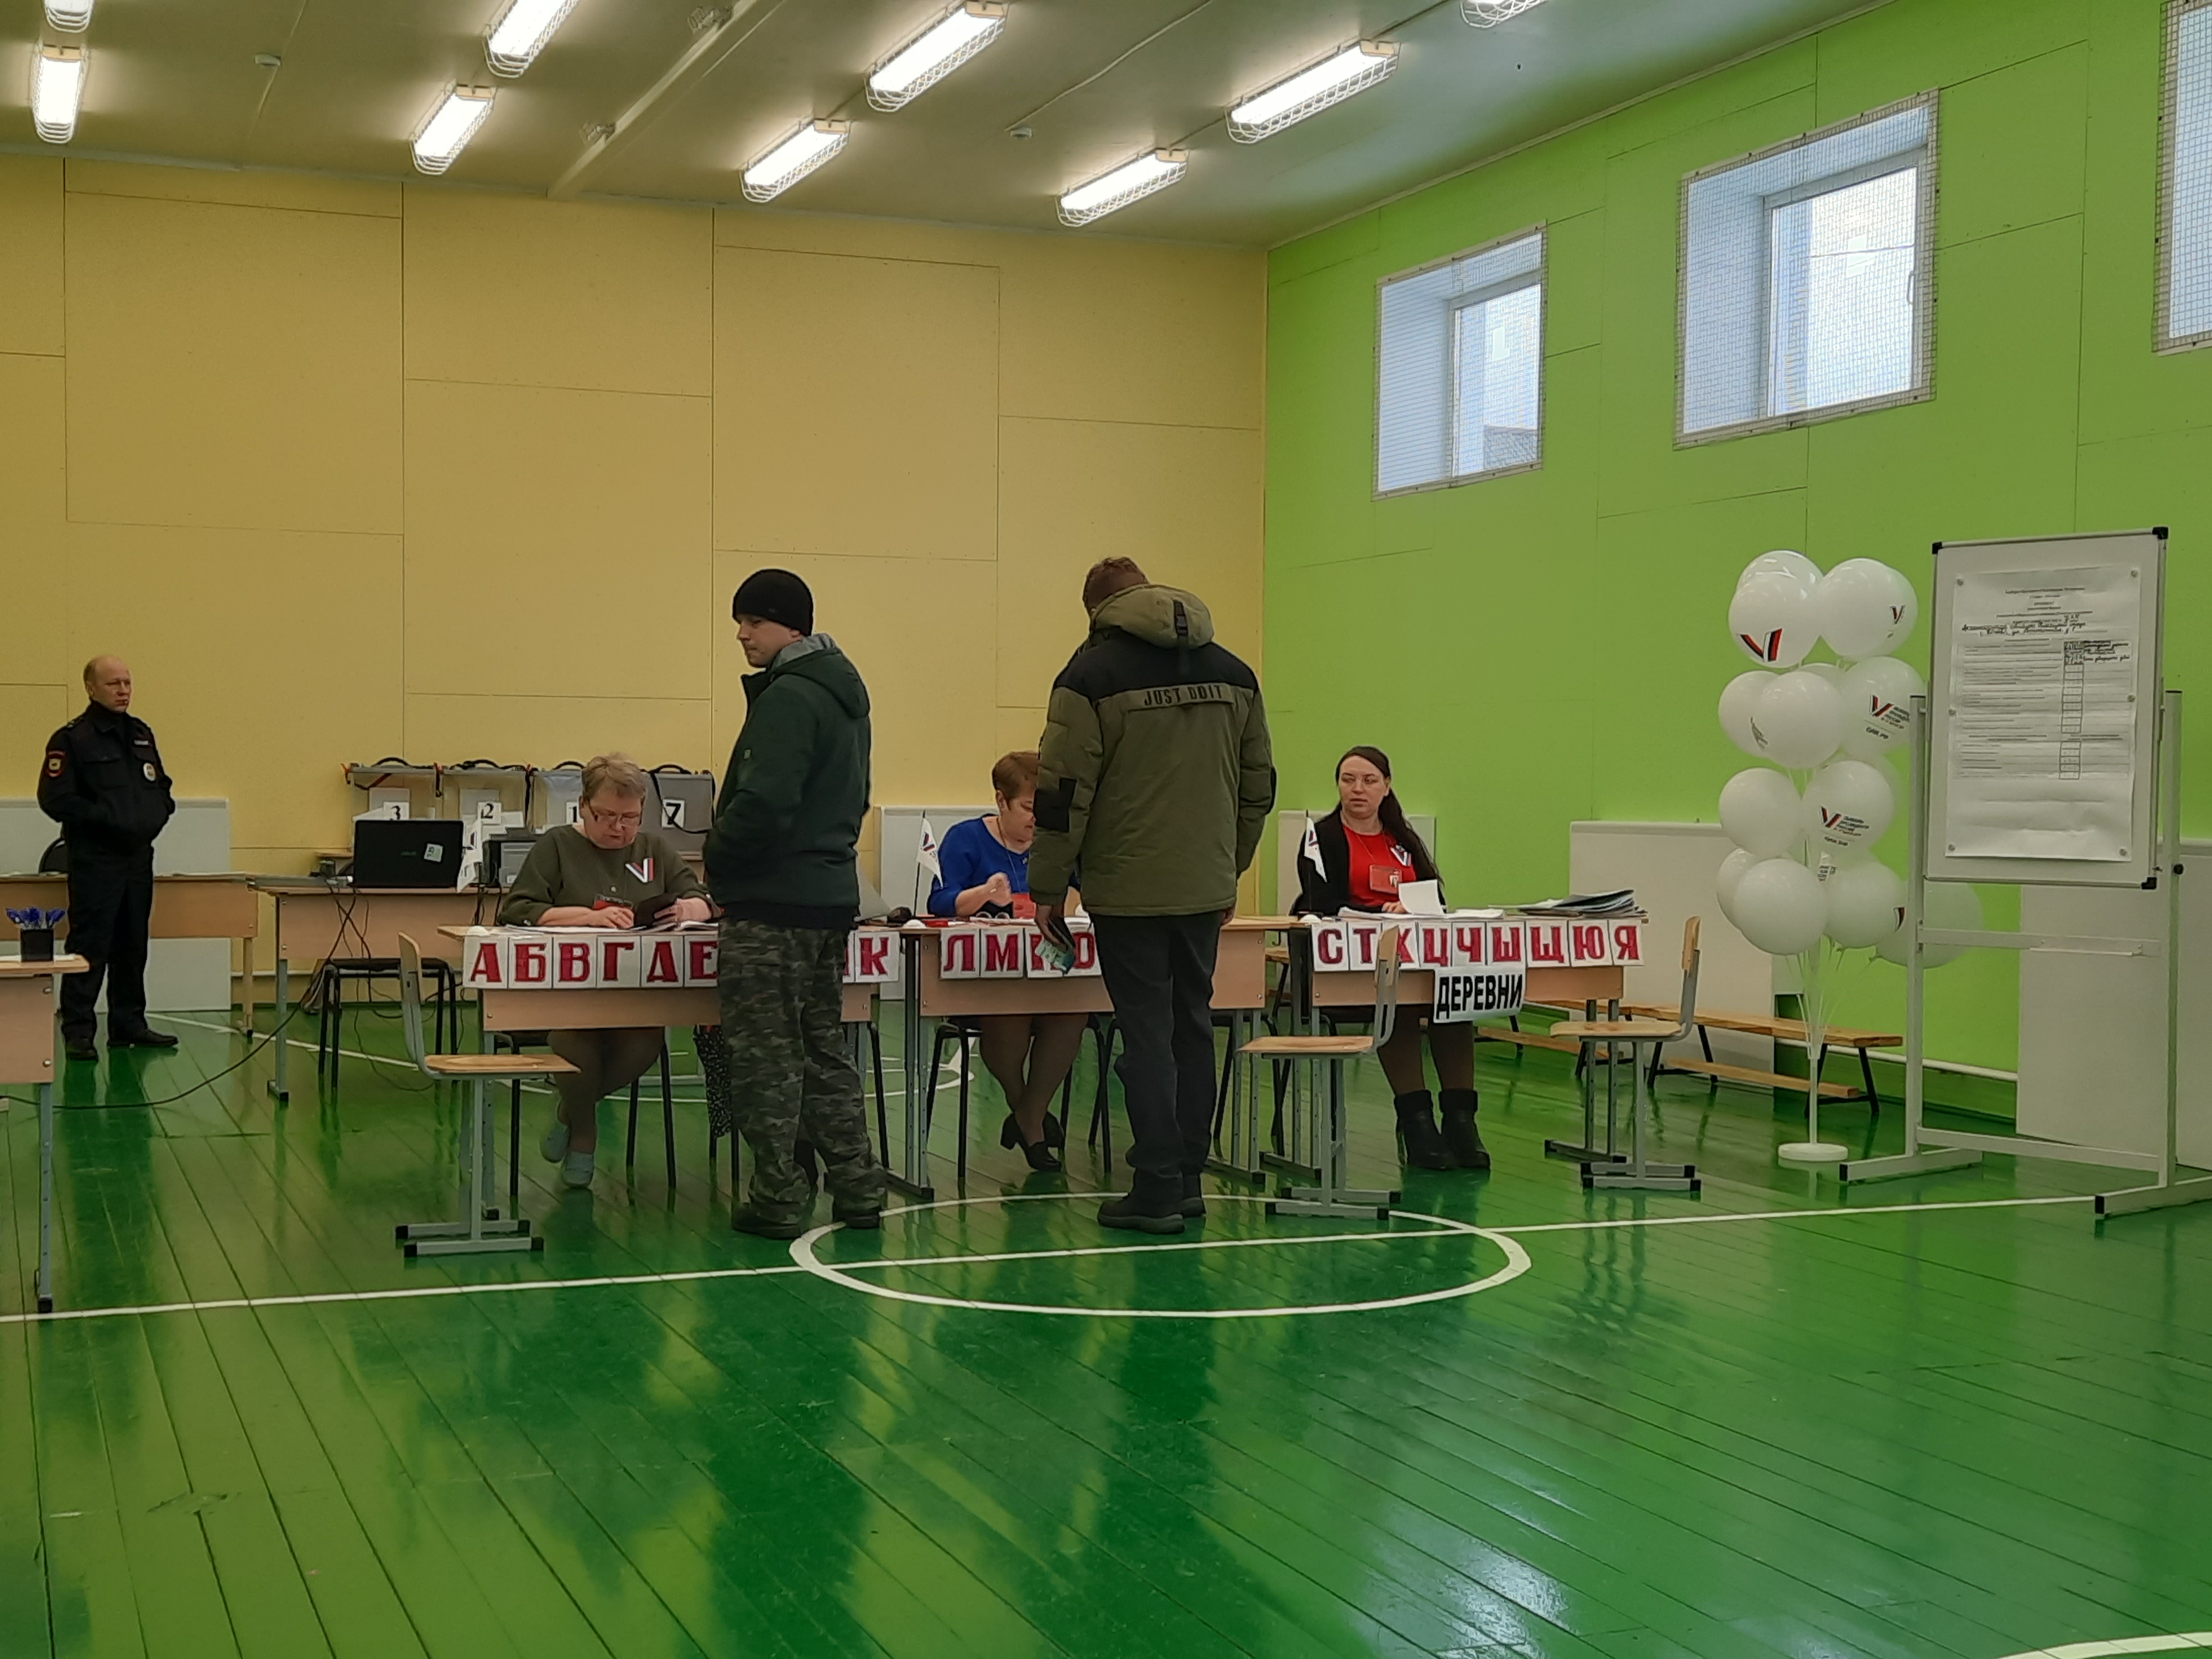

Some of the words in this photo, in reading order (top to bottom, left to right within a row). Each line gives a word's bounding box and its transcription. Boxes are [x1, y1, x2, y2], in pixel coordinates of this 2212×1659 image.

[1144, 688, 1181, 706] JUST
[391, 805, 401, 821] 3
[481, 803, 497, 819] 2
[665, 802, 682, 825] 7
[1436, 974, 1522, 1019] ДЕРЕВНИ
